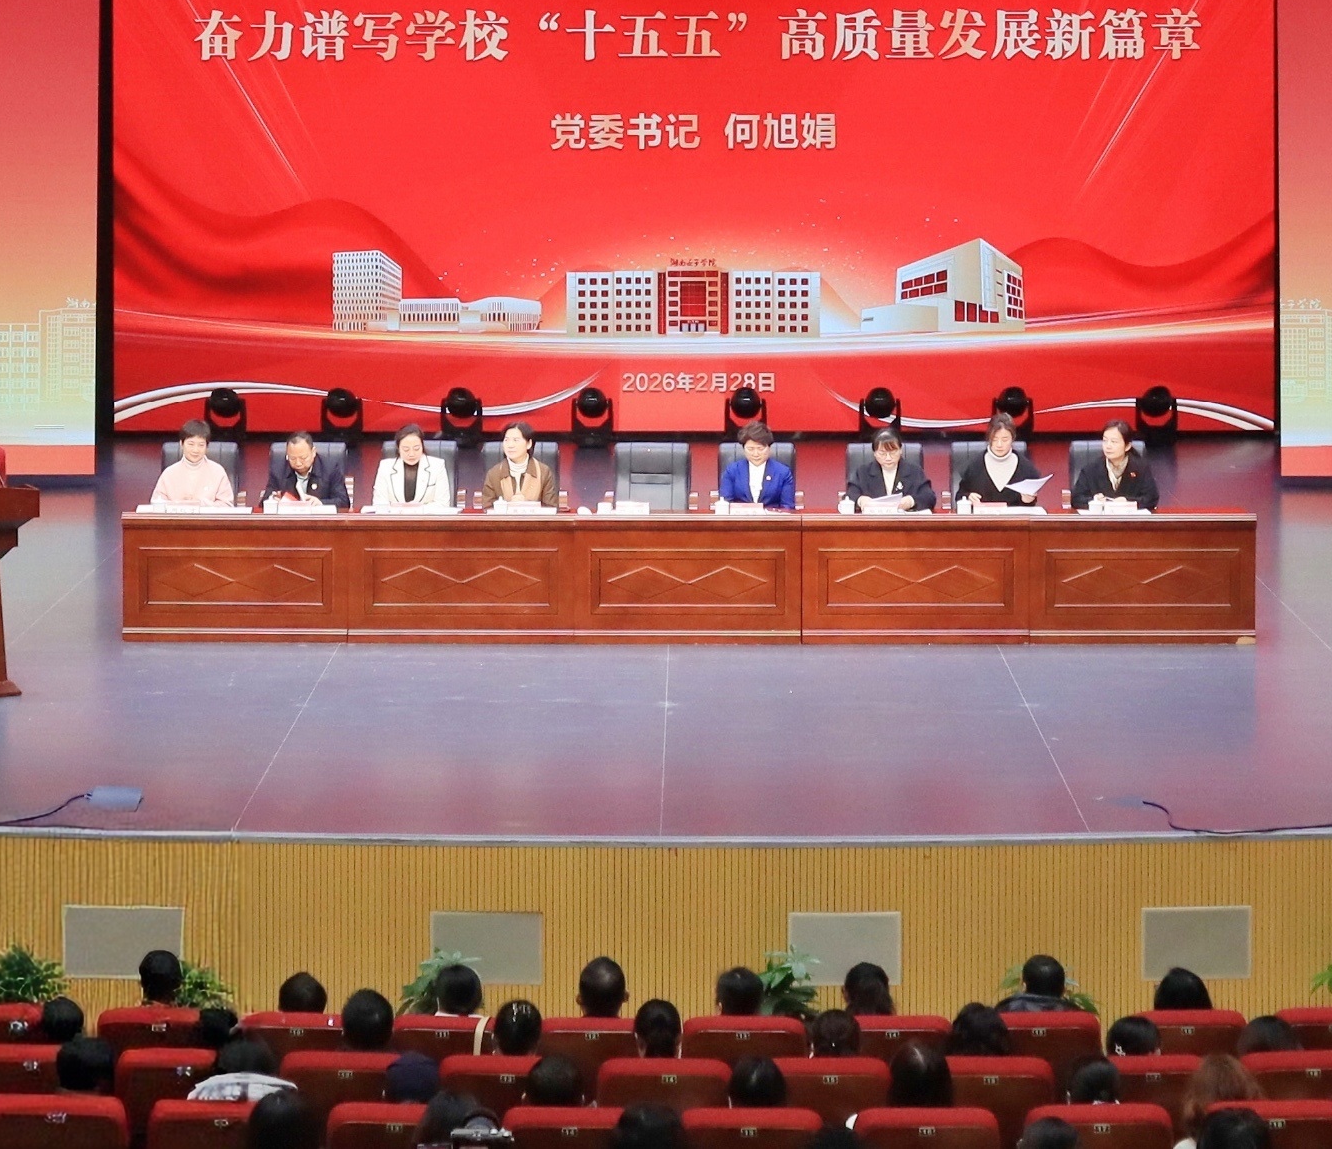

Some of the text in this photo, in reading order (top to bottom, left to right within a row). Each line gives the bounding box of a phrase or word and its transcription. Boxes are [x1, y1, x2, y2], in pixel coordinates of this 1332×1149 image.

[550, 112, 837, 150] 党委书记 何旭娟
[621, 371, 776, 393] 2026年2月28日
